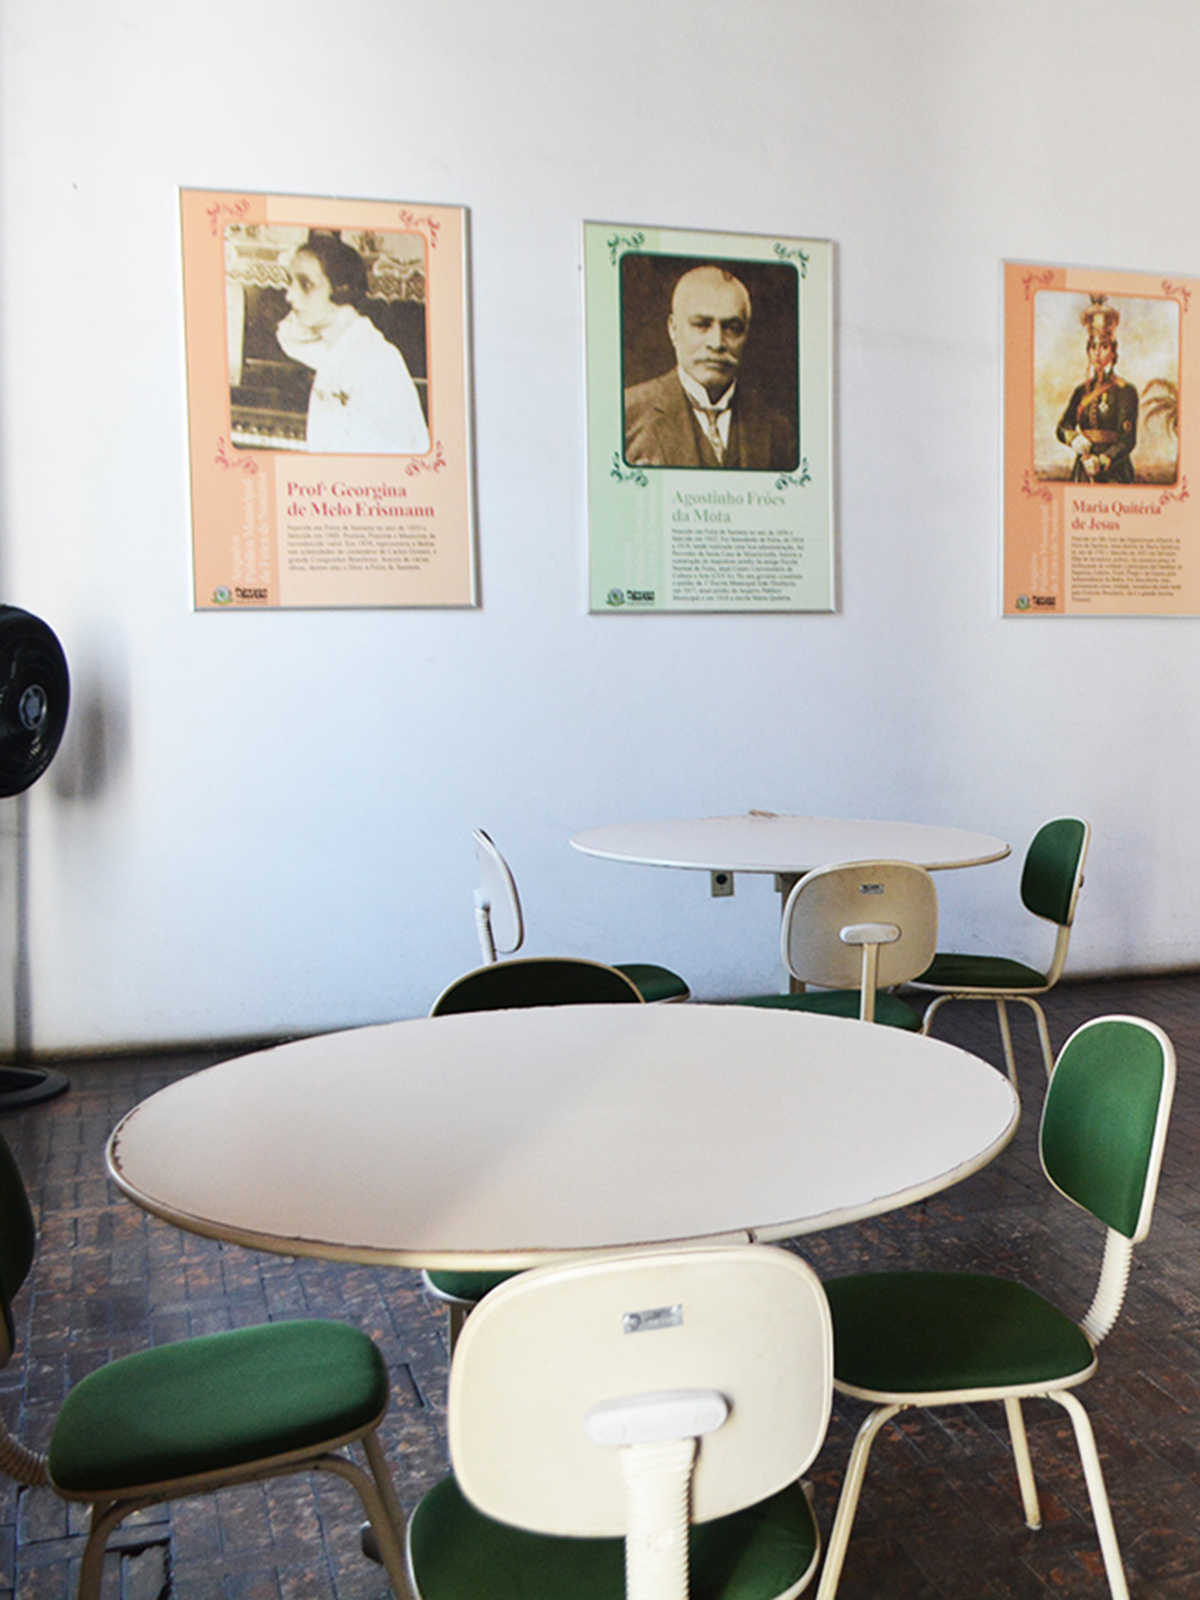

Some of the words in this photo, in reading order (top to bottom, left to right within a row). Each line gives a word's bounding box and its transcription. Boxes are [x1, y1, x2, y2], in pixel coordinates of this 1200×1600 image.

[331, 482, 408, 500] Georgina
[672, 490, 745, 507] Agostinho
[286, 502, 307, 517] de
[310, 502, 353, 517] Melo
[355, 502, 436, 518] Erismann
[671, 508, 691, 523] da
[693, 508, 732, 523] Mota
[1071, 499, 1110, 513] Maria
[1111, 500, 1162, 516] Quitéria
[1071, 517, 1086, 530] de
[1088, 517, 1121, 531] Jesus
